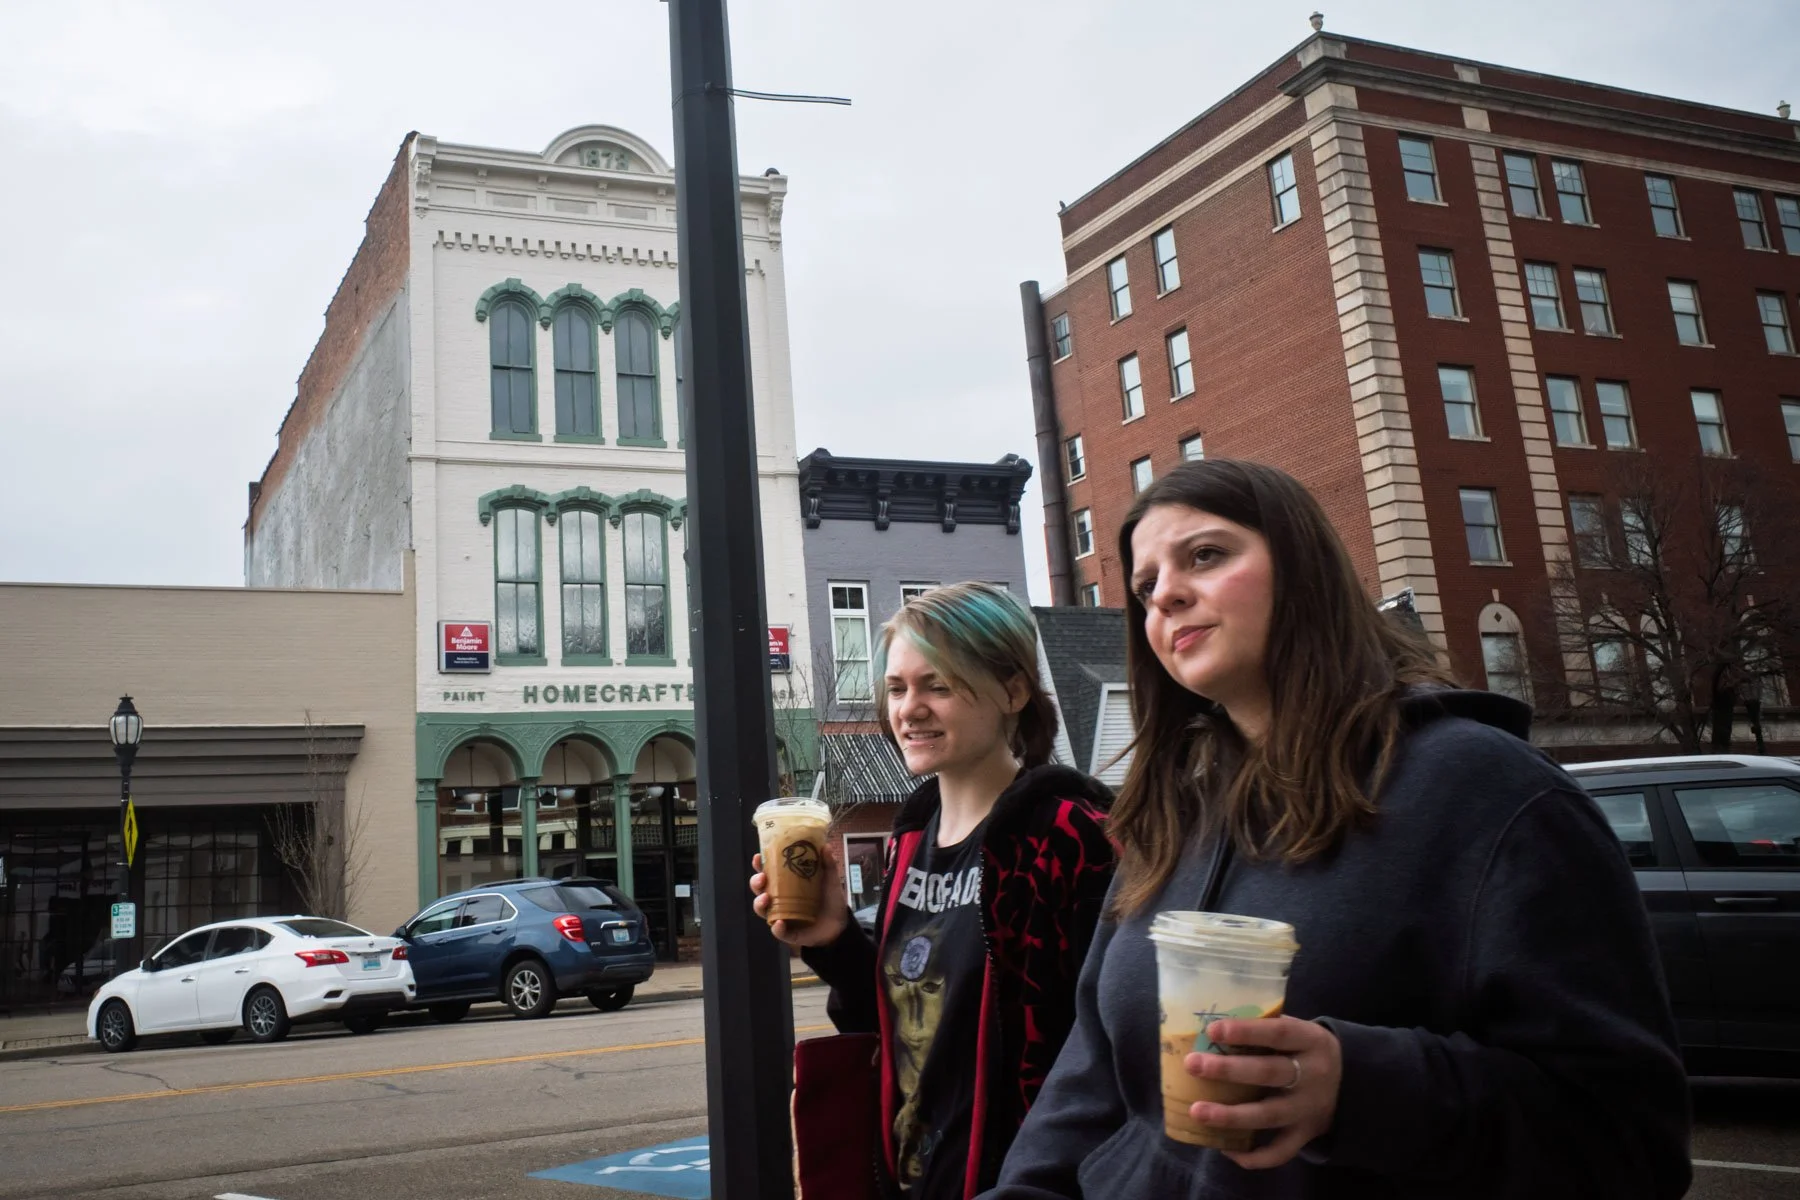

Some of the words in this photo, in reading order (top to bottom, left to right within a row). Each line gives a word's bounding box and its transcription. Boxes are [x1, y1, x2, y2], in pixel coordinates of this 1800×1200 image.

[451, 637, 482, 645] Benjamin
[443, 691, 485, 702] PAINT
[523, 684, 695, 704] HOMECRAFTE
